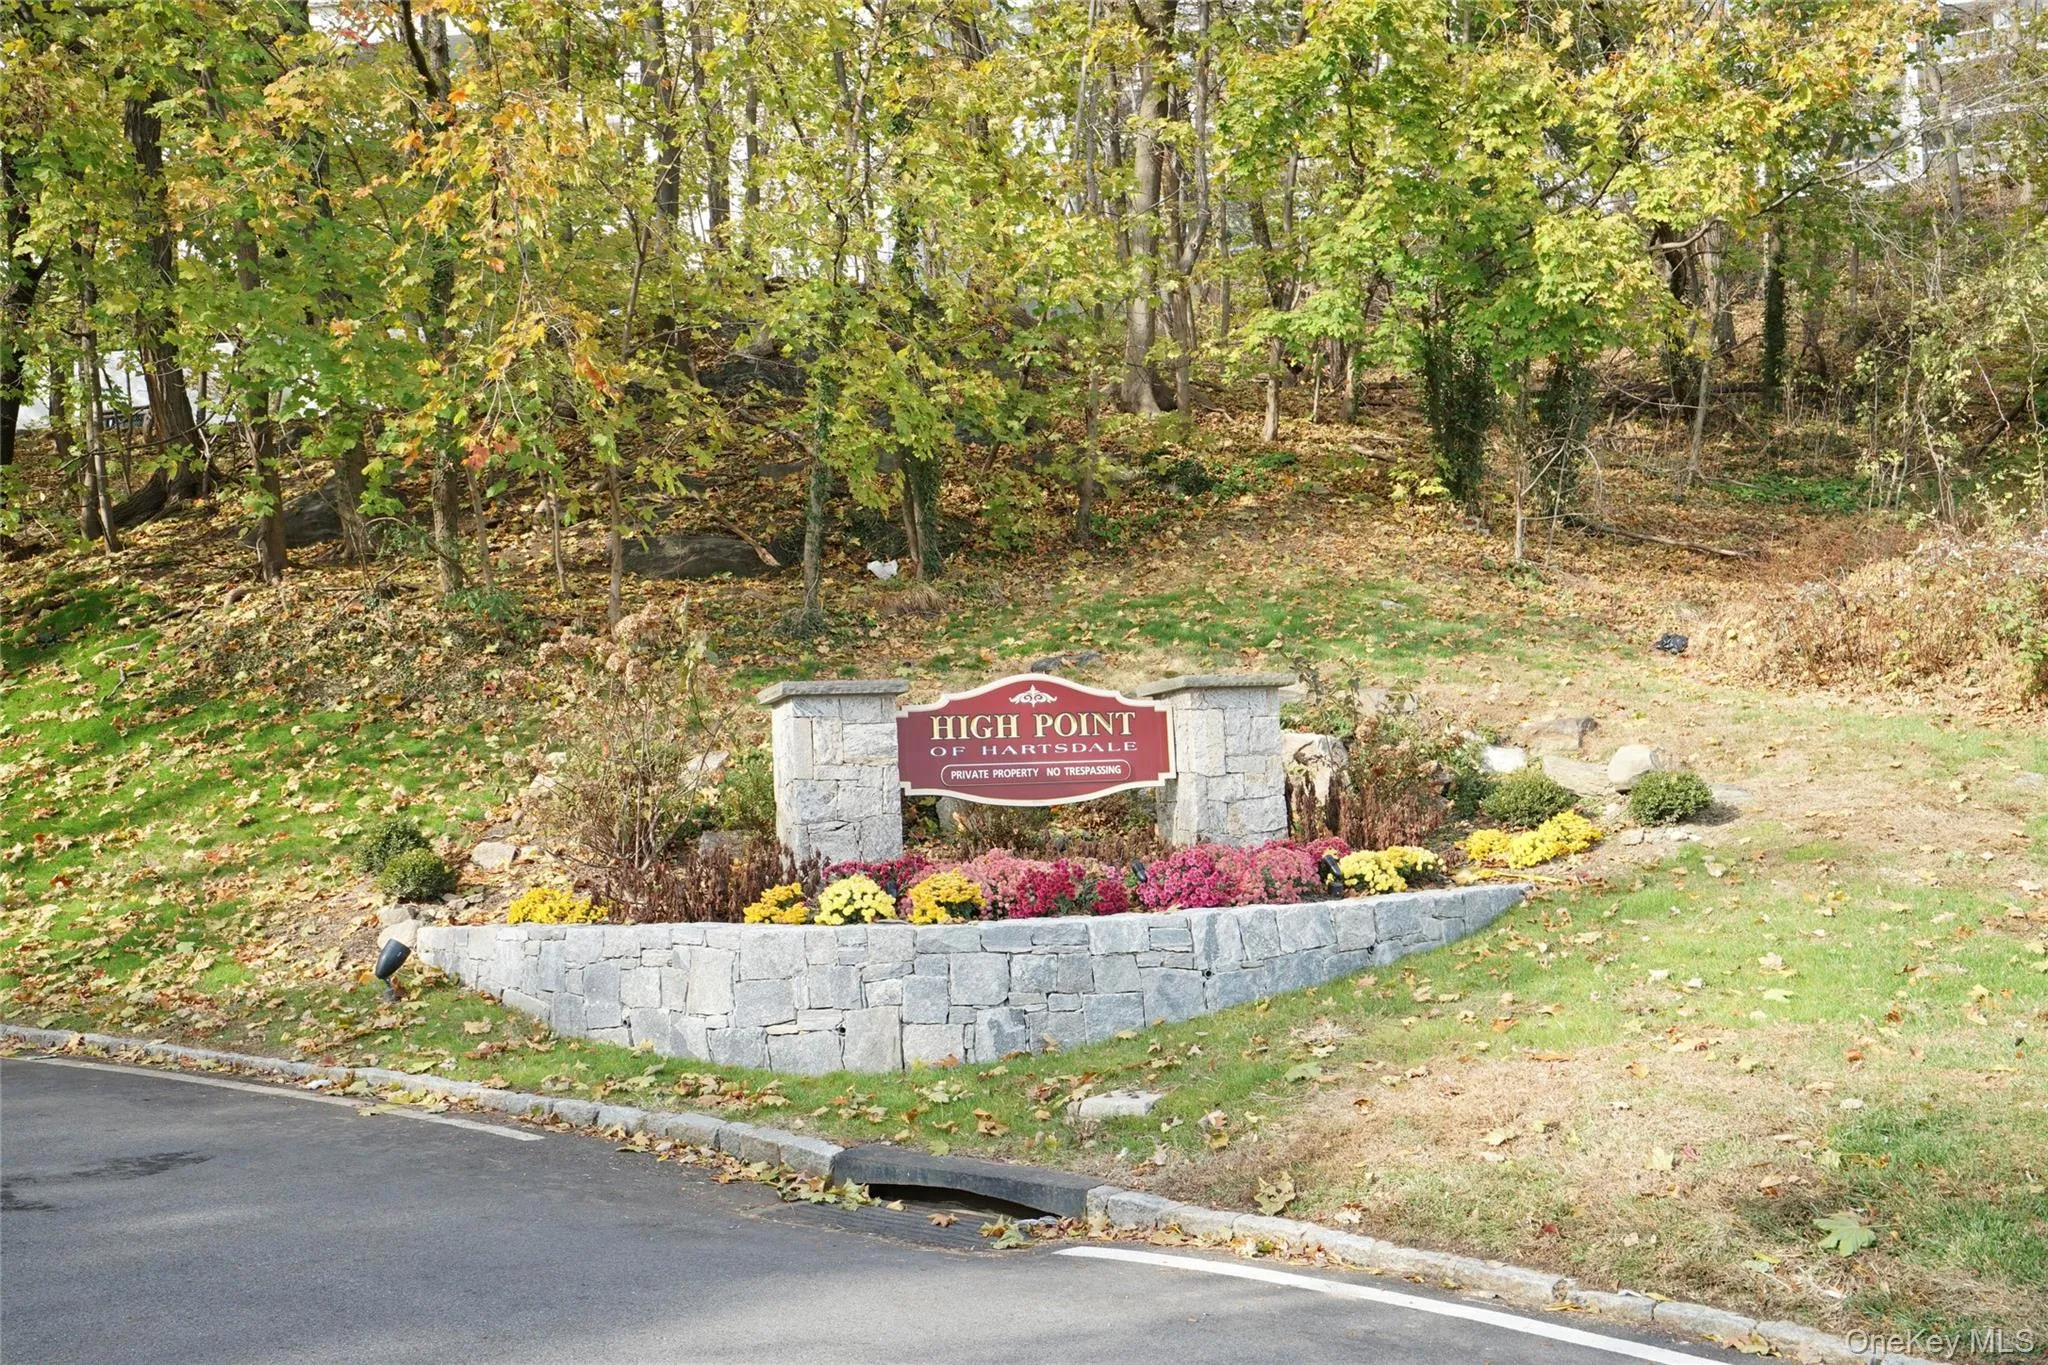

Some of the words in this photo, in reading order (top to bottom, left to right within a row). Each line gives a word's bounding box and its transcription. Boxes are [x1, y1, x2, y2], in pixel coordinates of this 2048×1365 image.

[930, 713, 1020, 740] HIGH
[1033, 711, 1136, 738] POINT
[930, 746, 966, 757] OF
[982, 741, 1137, 756] HARTSDALE
[951, 769, 989, 780] PRIVATE
[992, 767, 1039, 778] PROPERTY
[1046, 767, 1061, 777] NO
[1064, 764, 1122, 776] TRESPASSING
